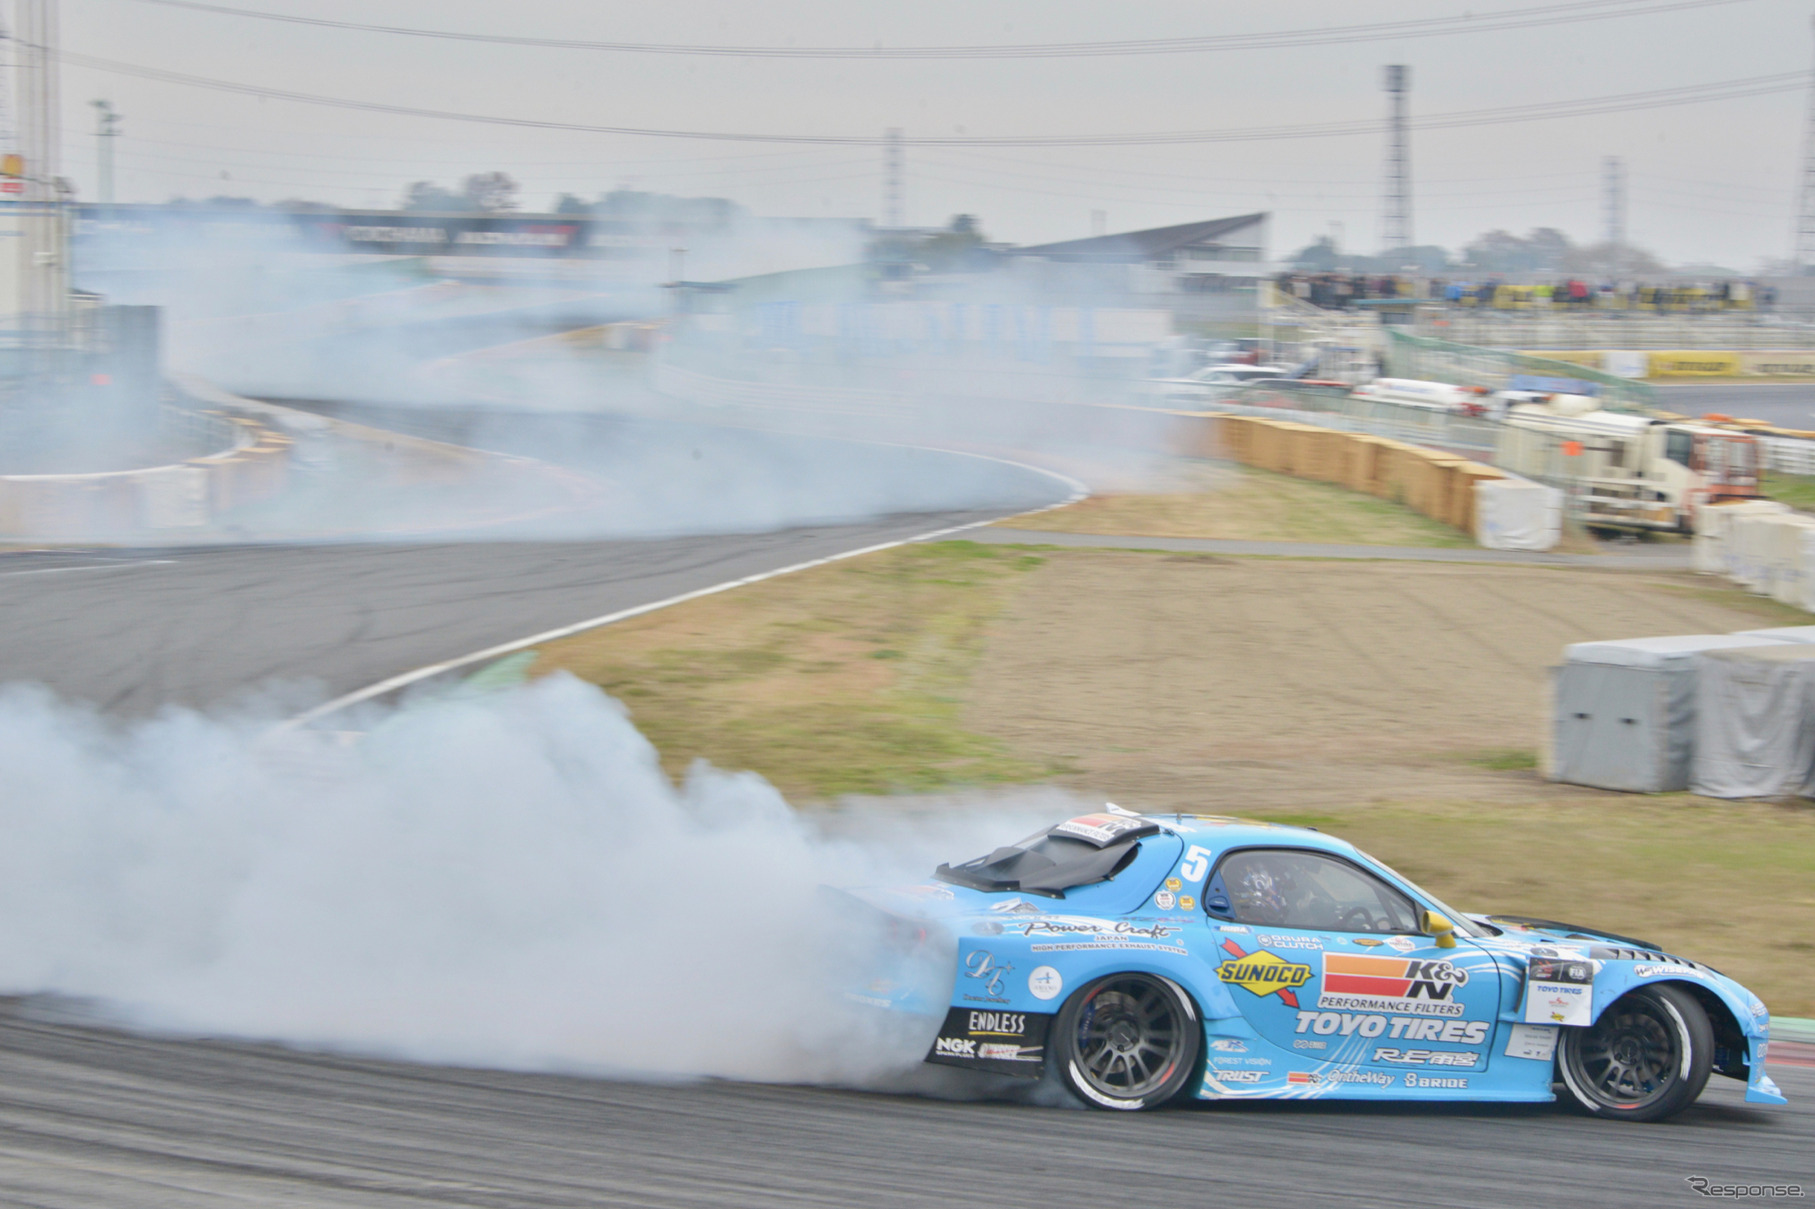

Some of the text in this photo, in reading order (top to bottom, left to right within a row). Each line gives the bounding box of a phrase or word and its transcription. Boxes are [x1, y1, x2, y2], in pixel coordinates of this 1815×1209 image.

[1181, 845, 1211, 882] 5
[1019, 921, 1182, 939] Power Craft
[1272, 935, 1322, 943] OGURA
[1273, 941, 1324, 950] CLUTCH
[1055, 942, 1119, 950] PERFORMANCE
[1158, 945, 1188, 956] SYSTEM
[1221, 963, 1307, 983] SUNOCO
[1537, 985, 1582, 995] TOYO TIRES
[1320, 997, 1463, 1016] PERFORMANCE FILTERS
[968, 1011, 1026, 1034] ENDLESS
[1296, 1011, 1491, 1045] TOYO TIRES
[936, 1037, 977, 1054] NGK
[1213, 1056, 1272, 1066] FOREST VISION
[1213, 1070, 1270, 1082] TRUST
[1327, 1068, 1396, 1089] OntheWay
[1419, 1077, 1469, 1089] BRIDE
